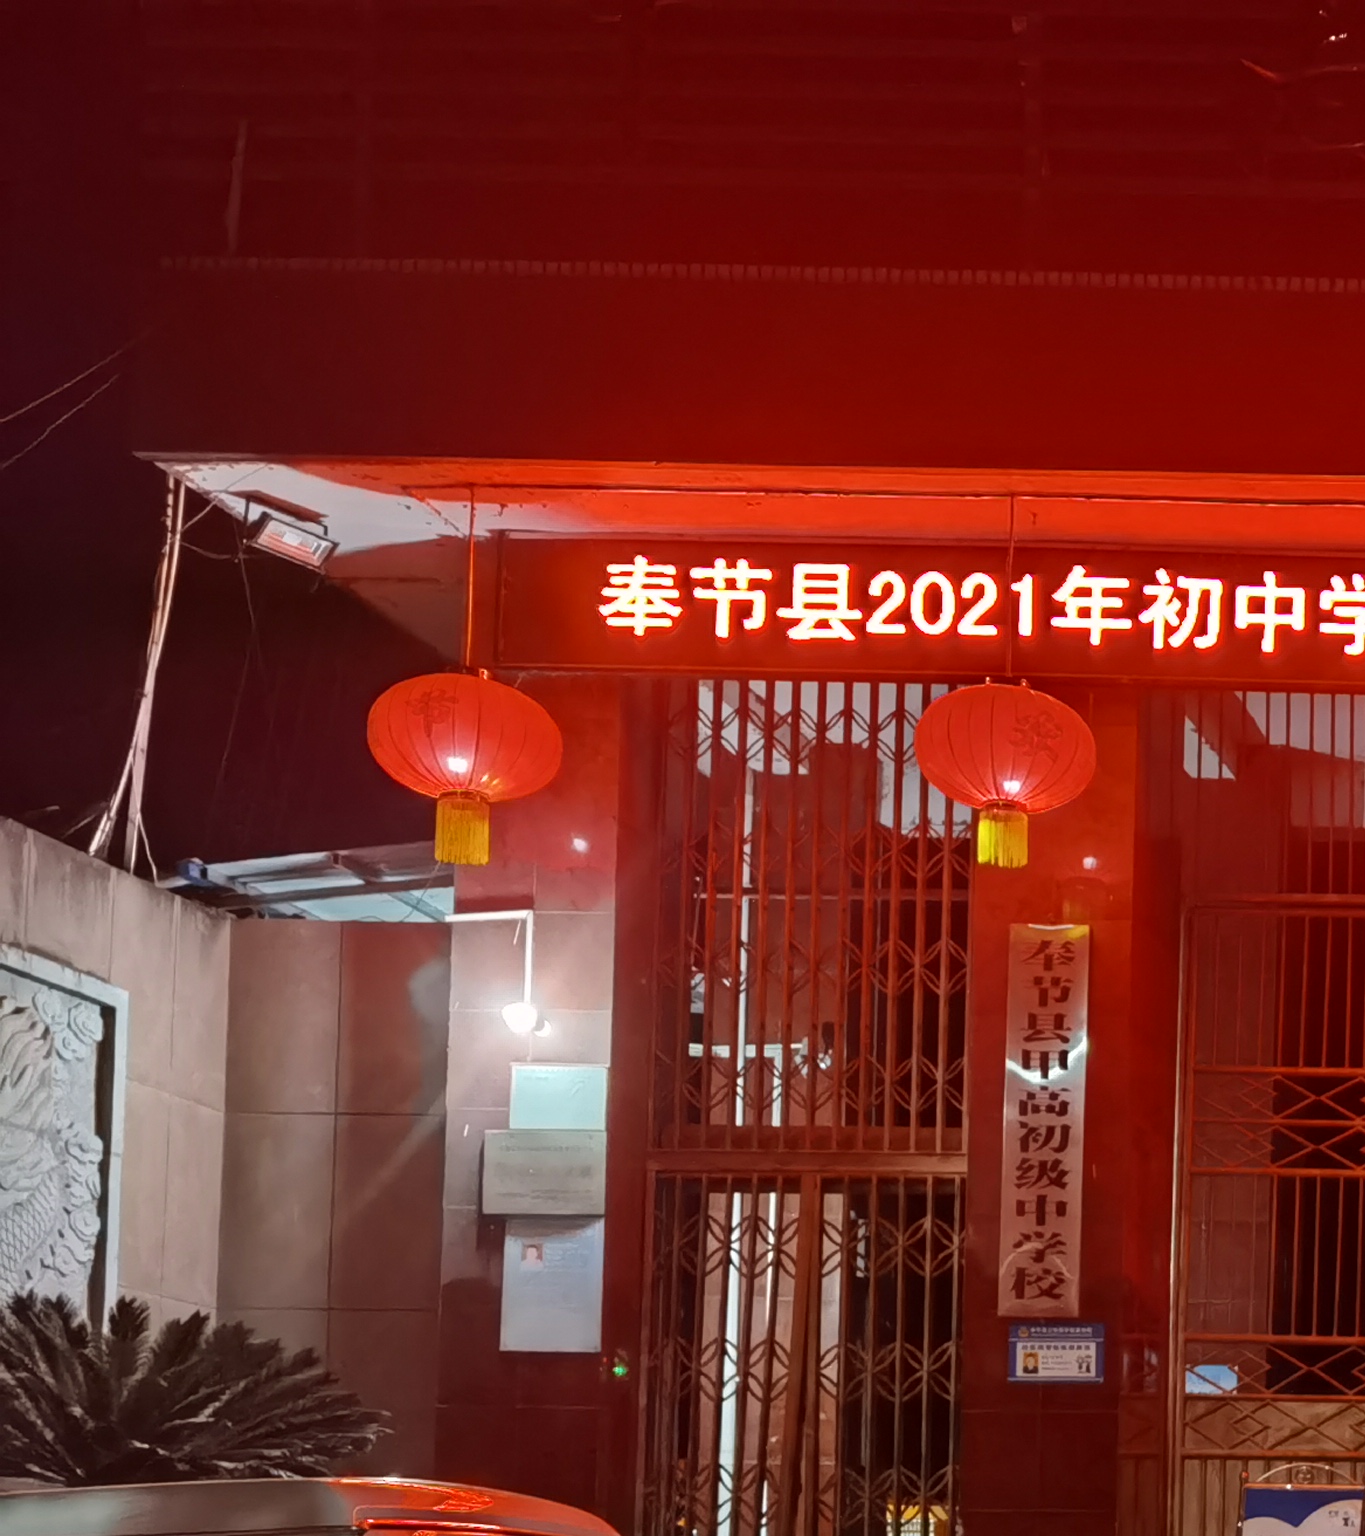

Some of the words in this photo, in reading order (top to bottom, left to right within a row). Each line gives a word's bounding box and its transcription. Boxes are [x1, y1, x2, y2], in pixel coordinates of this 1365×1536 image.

[1009, 938, 1077, 1303] 奉节县甲高初级中学校
